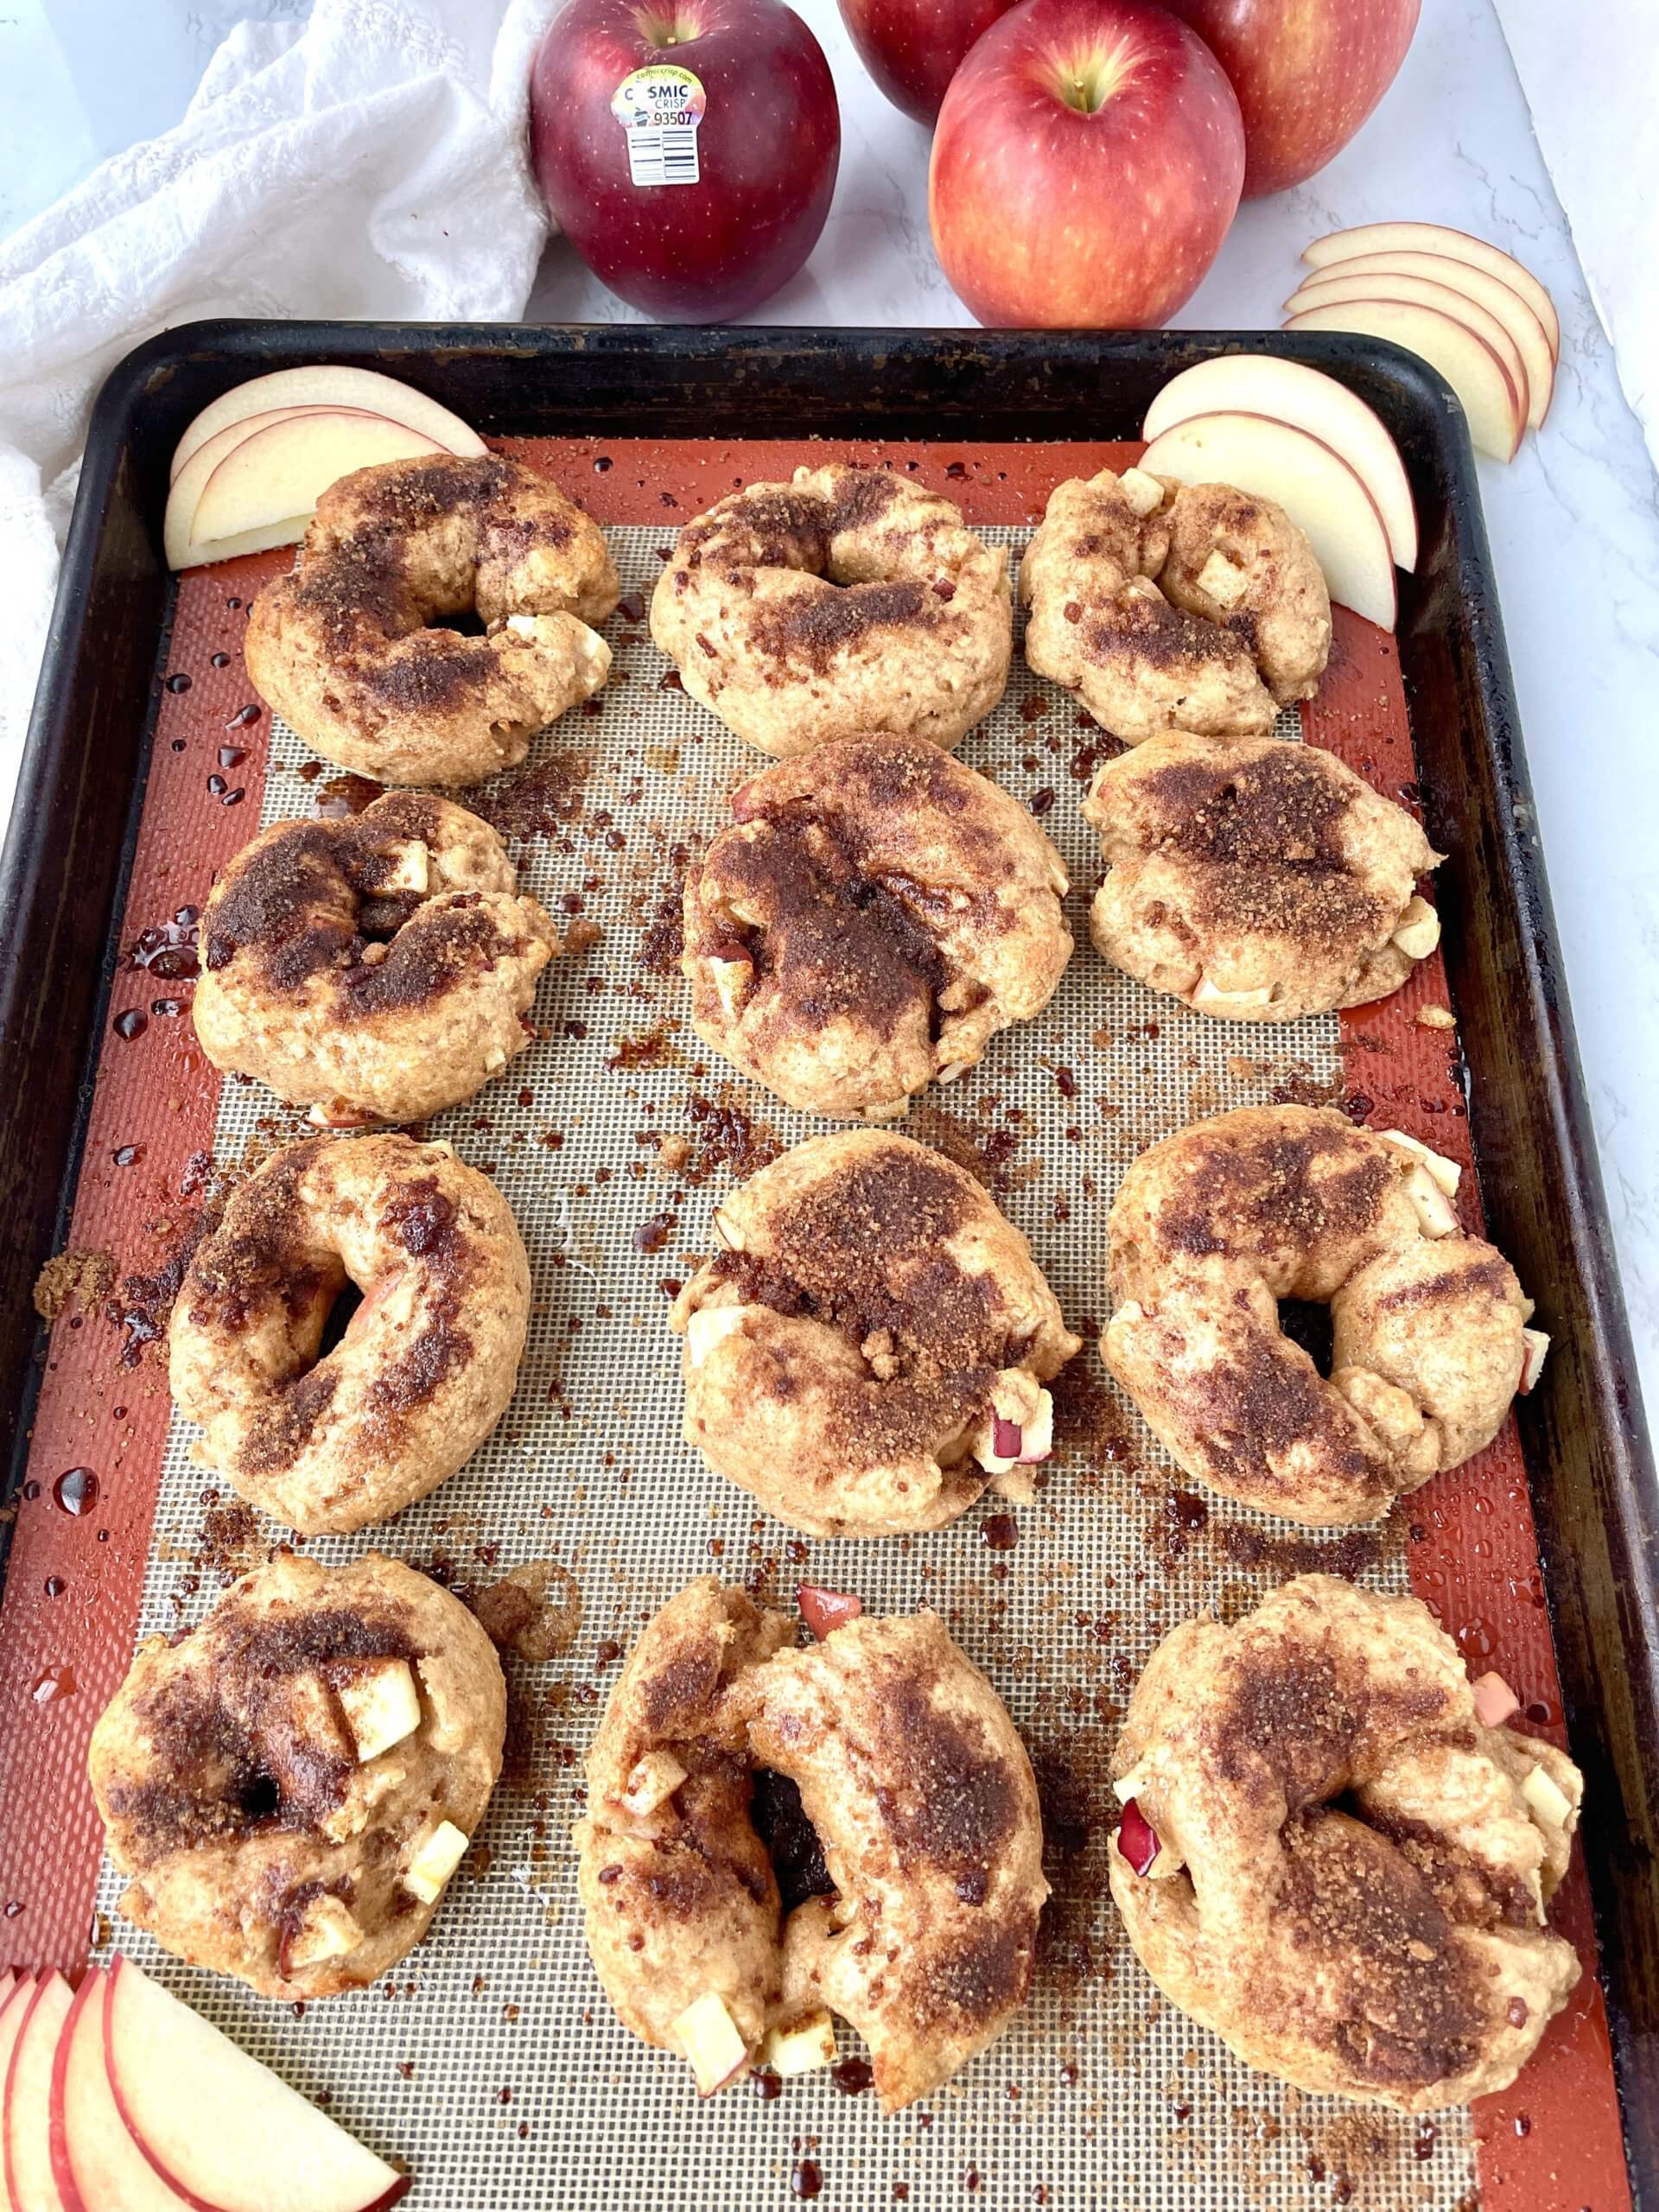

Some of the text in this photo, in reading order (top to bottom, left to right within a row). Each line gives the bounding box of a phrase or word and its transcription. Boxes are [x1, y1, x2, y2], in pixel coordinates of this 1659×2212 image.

[625, 85, 689, 100] CSMIC
[655, 99, 686, 109] CRISP
[654, 111, 692, 126] 93507
